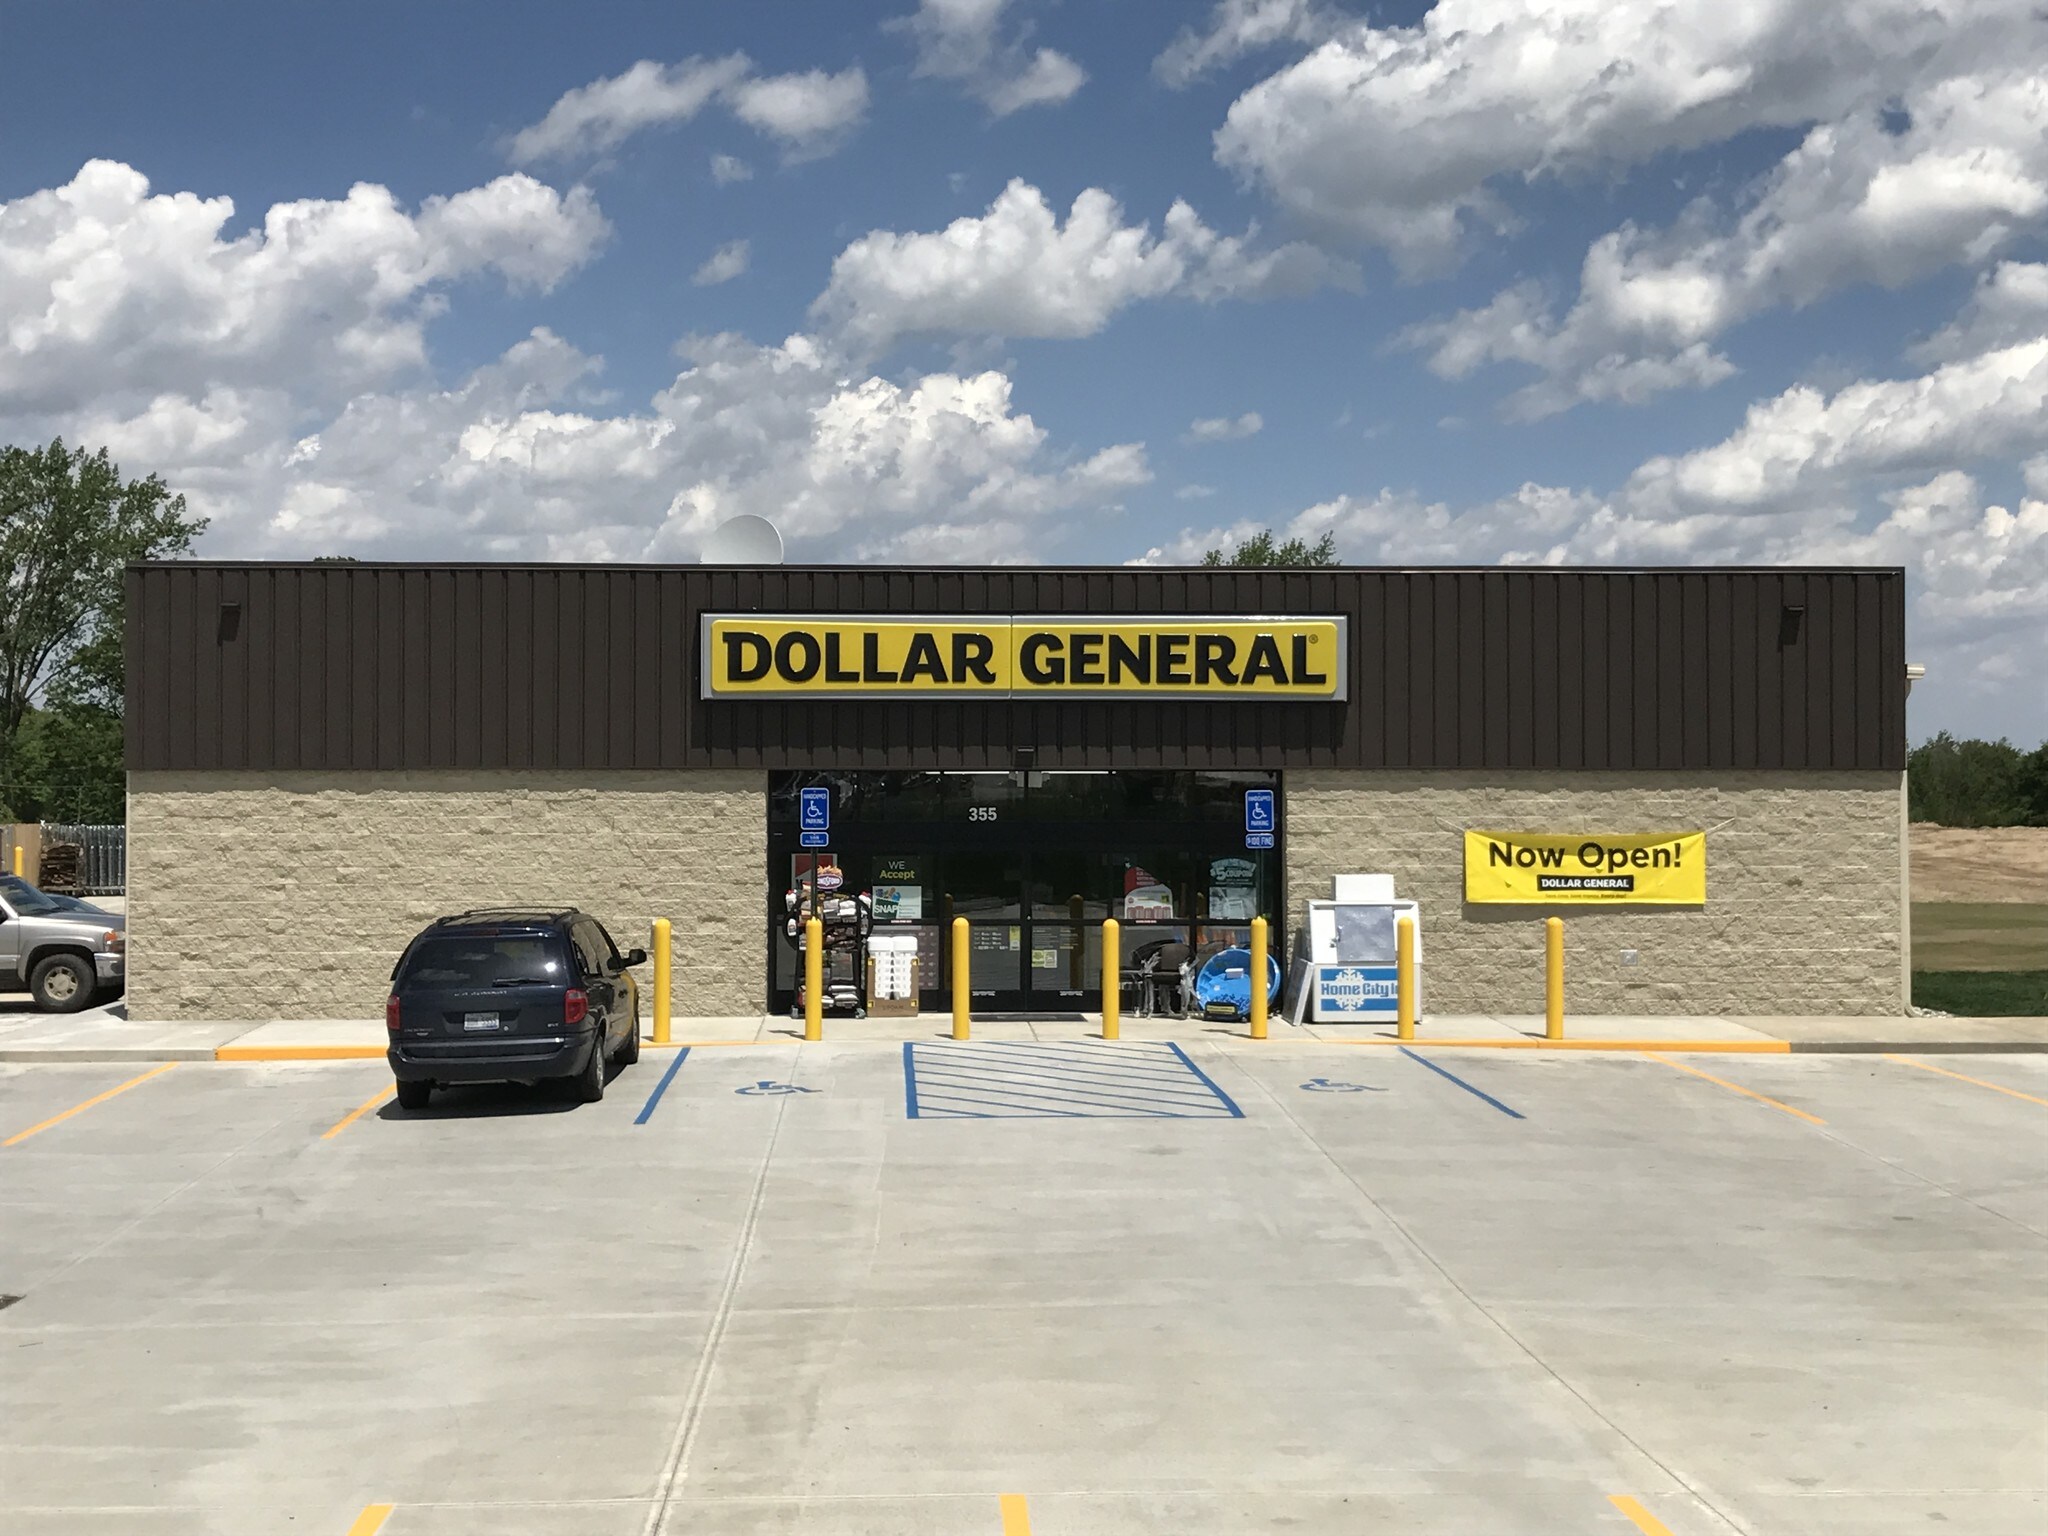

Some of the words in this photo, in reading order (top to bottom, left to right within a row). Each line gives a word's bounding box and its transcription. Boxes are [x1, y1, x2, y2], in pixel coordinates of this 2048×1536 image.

[721, 631, 997, 684] DOLLAR
[1018, 632, 1327, 687] GENERAL
[968, 807, 997, 821] 355
[1489, 841, 1566, 868] Now
[1577, 841, 1682, 874] Open!
[888, 860, 905, 870] WE
[879, 870, 916, 881] Accept
[1541, 879, 1582, 888] DOLLAR
[1583, 879, 1630, 888] GENERAL
[874, 904, 899, 914] SNAP
[1321, 983, 1361, 995] Home
[1362, 982, 1389, 997] City
